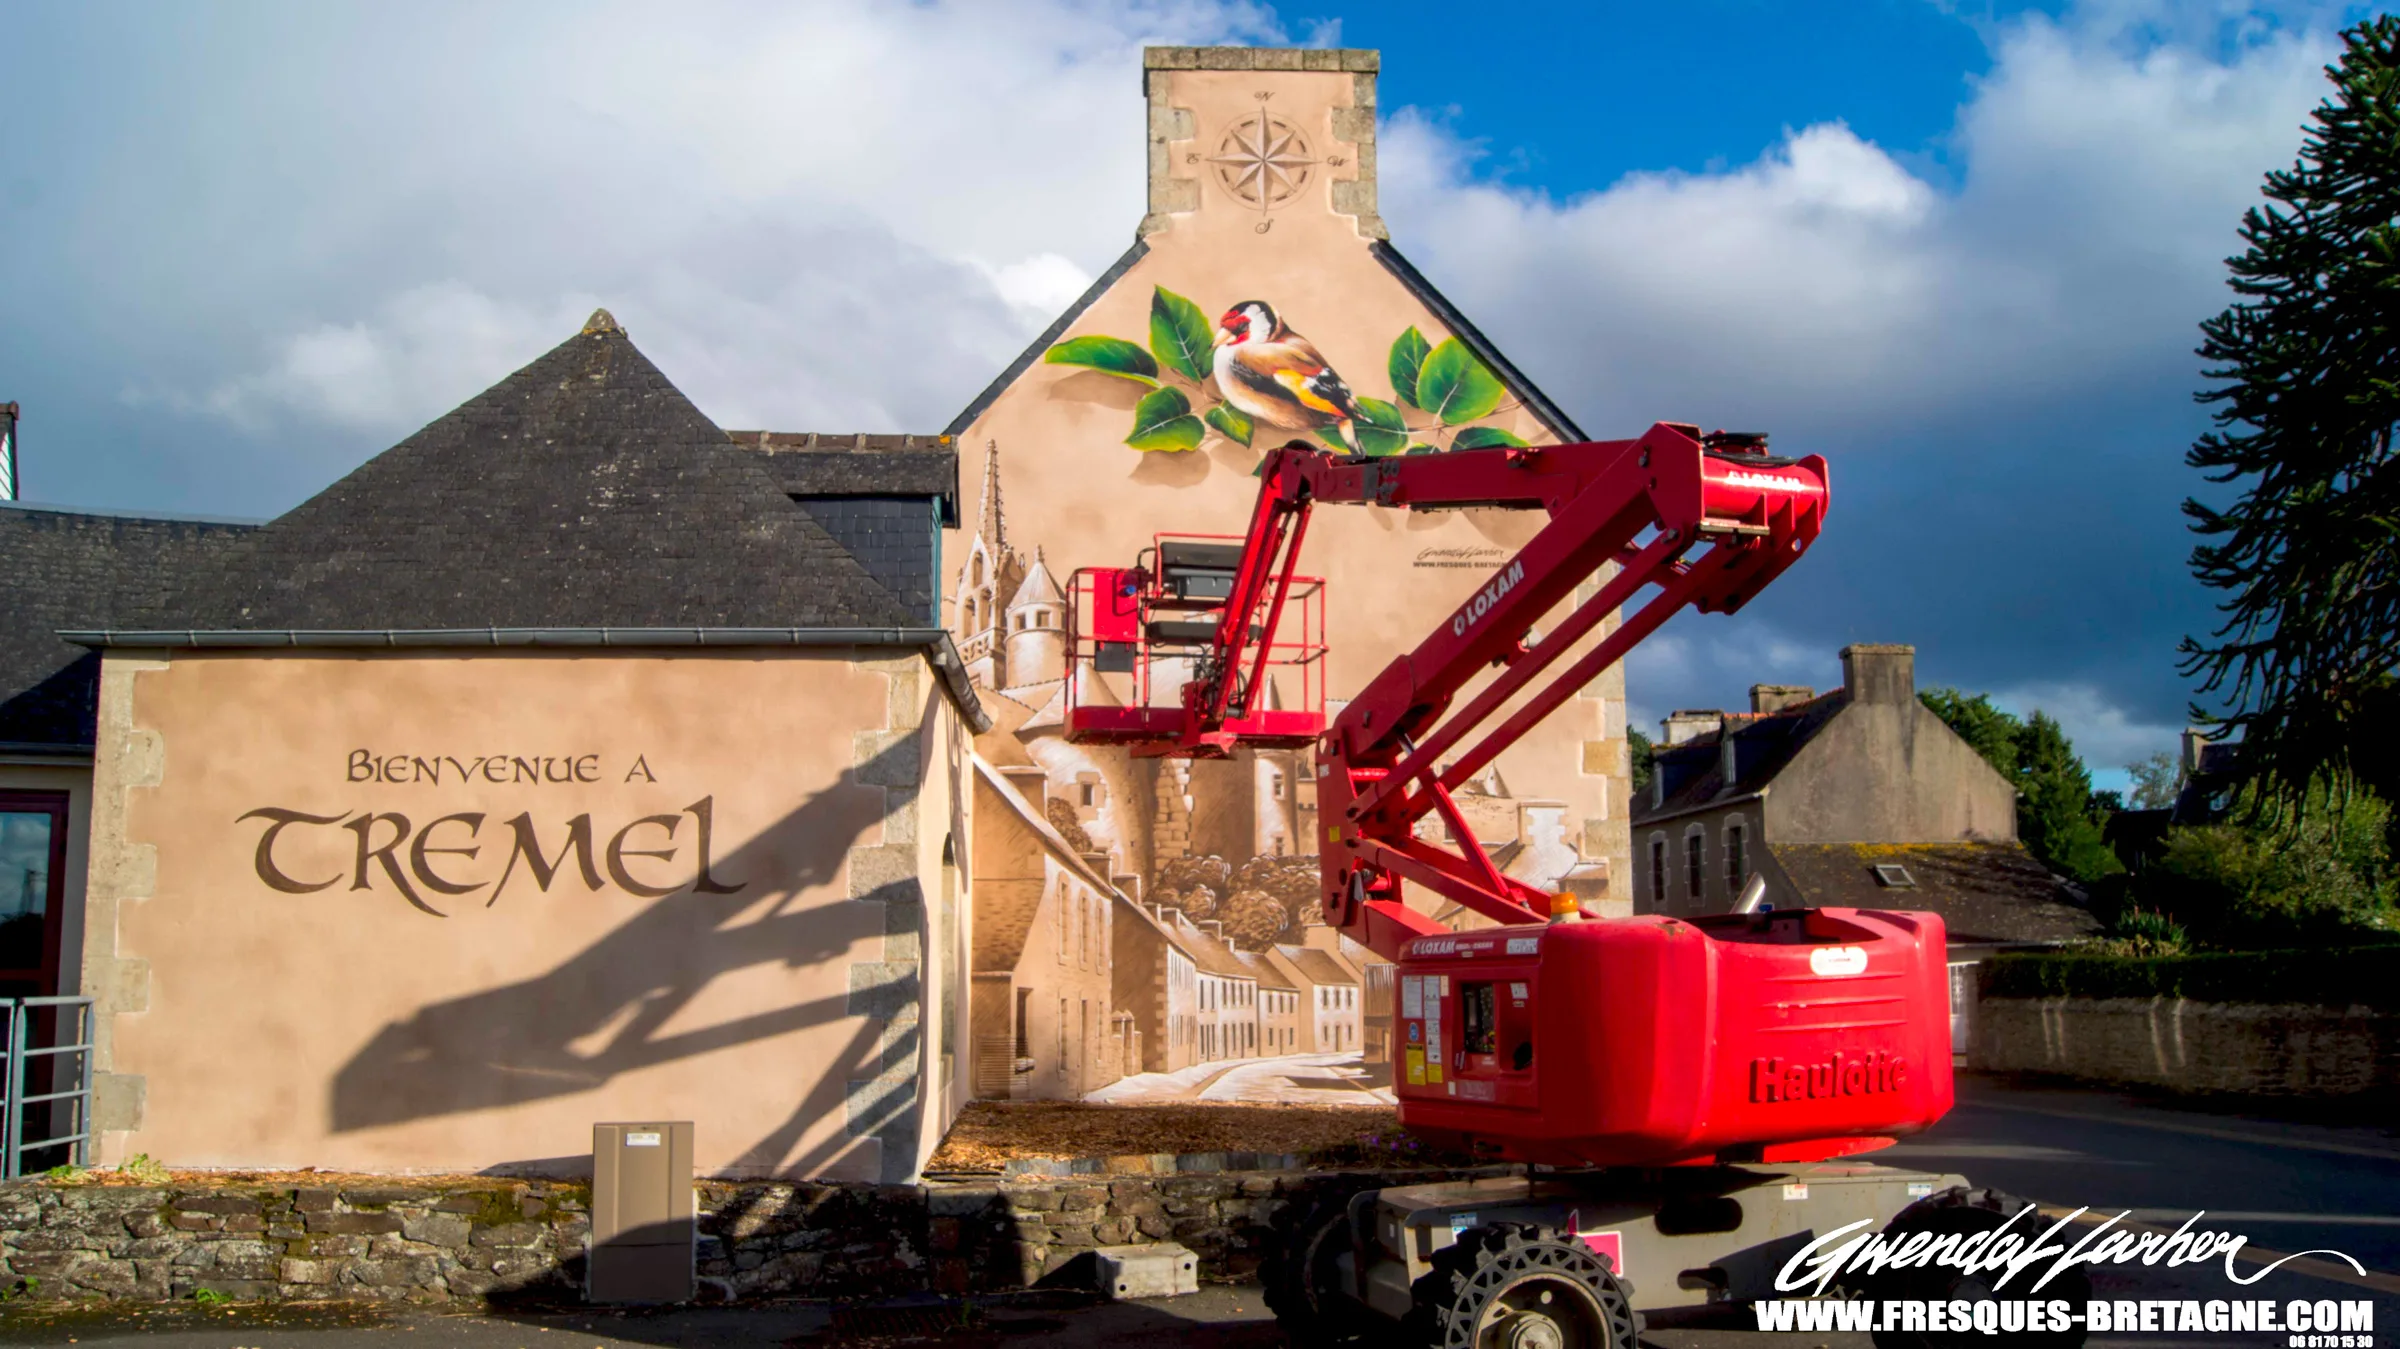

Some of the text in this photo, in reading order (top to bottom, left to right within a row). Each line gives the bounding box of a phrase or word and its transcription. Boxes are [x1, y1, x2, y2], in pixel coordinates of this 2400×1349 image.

[1255, 219, 1274, 234] S
[1466, 560, 1525, 625] LOXAM
[347, 748, 657, 786] BIENVENUE A
[1421, 941, 1456, 954] LOXAM
[1748, 1052, 1908, 1103] Haulotte
